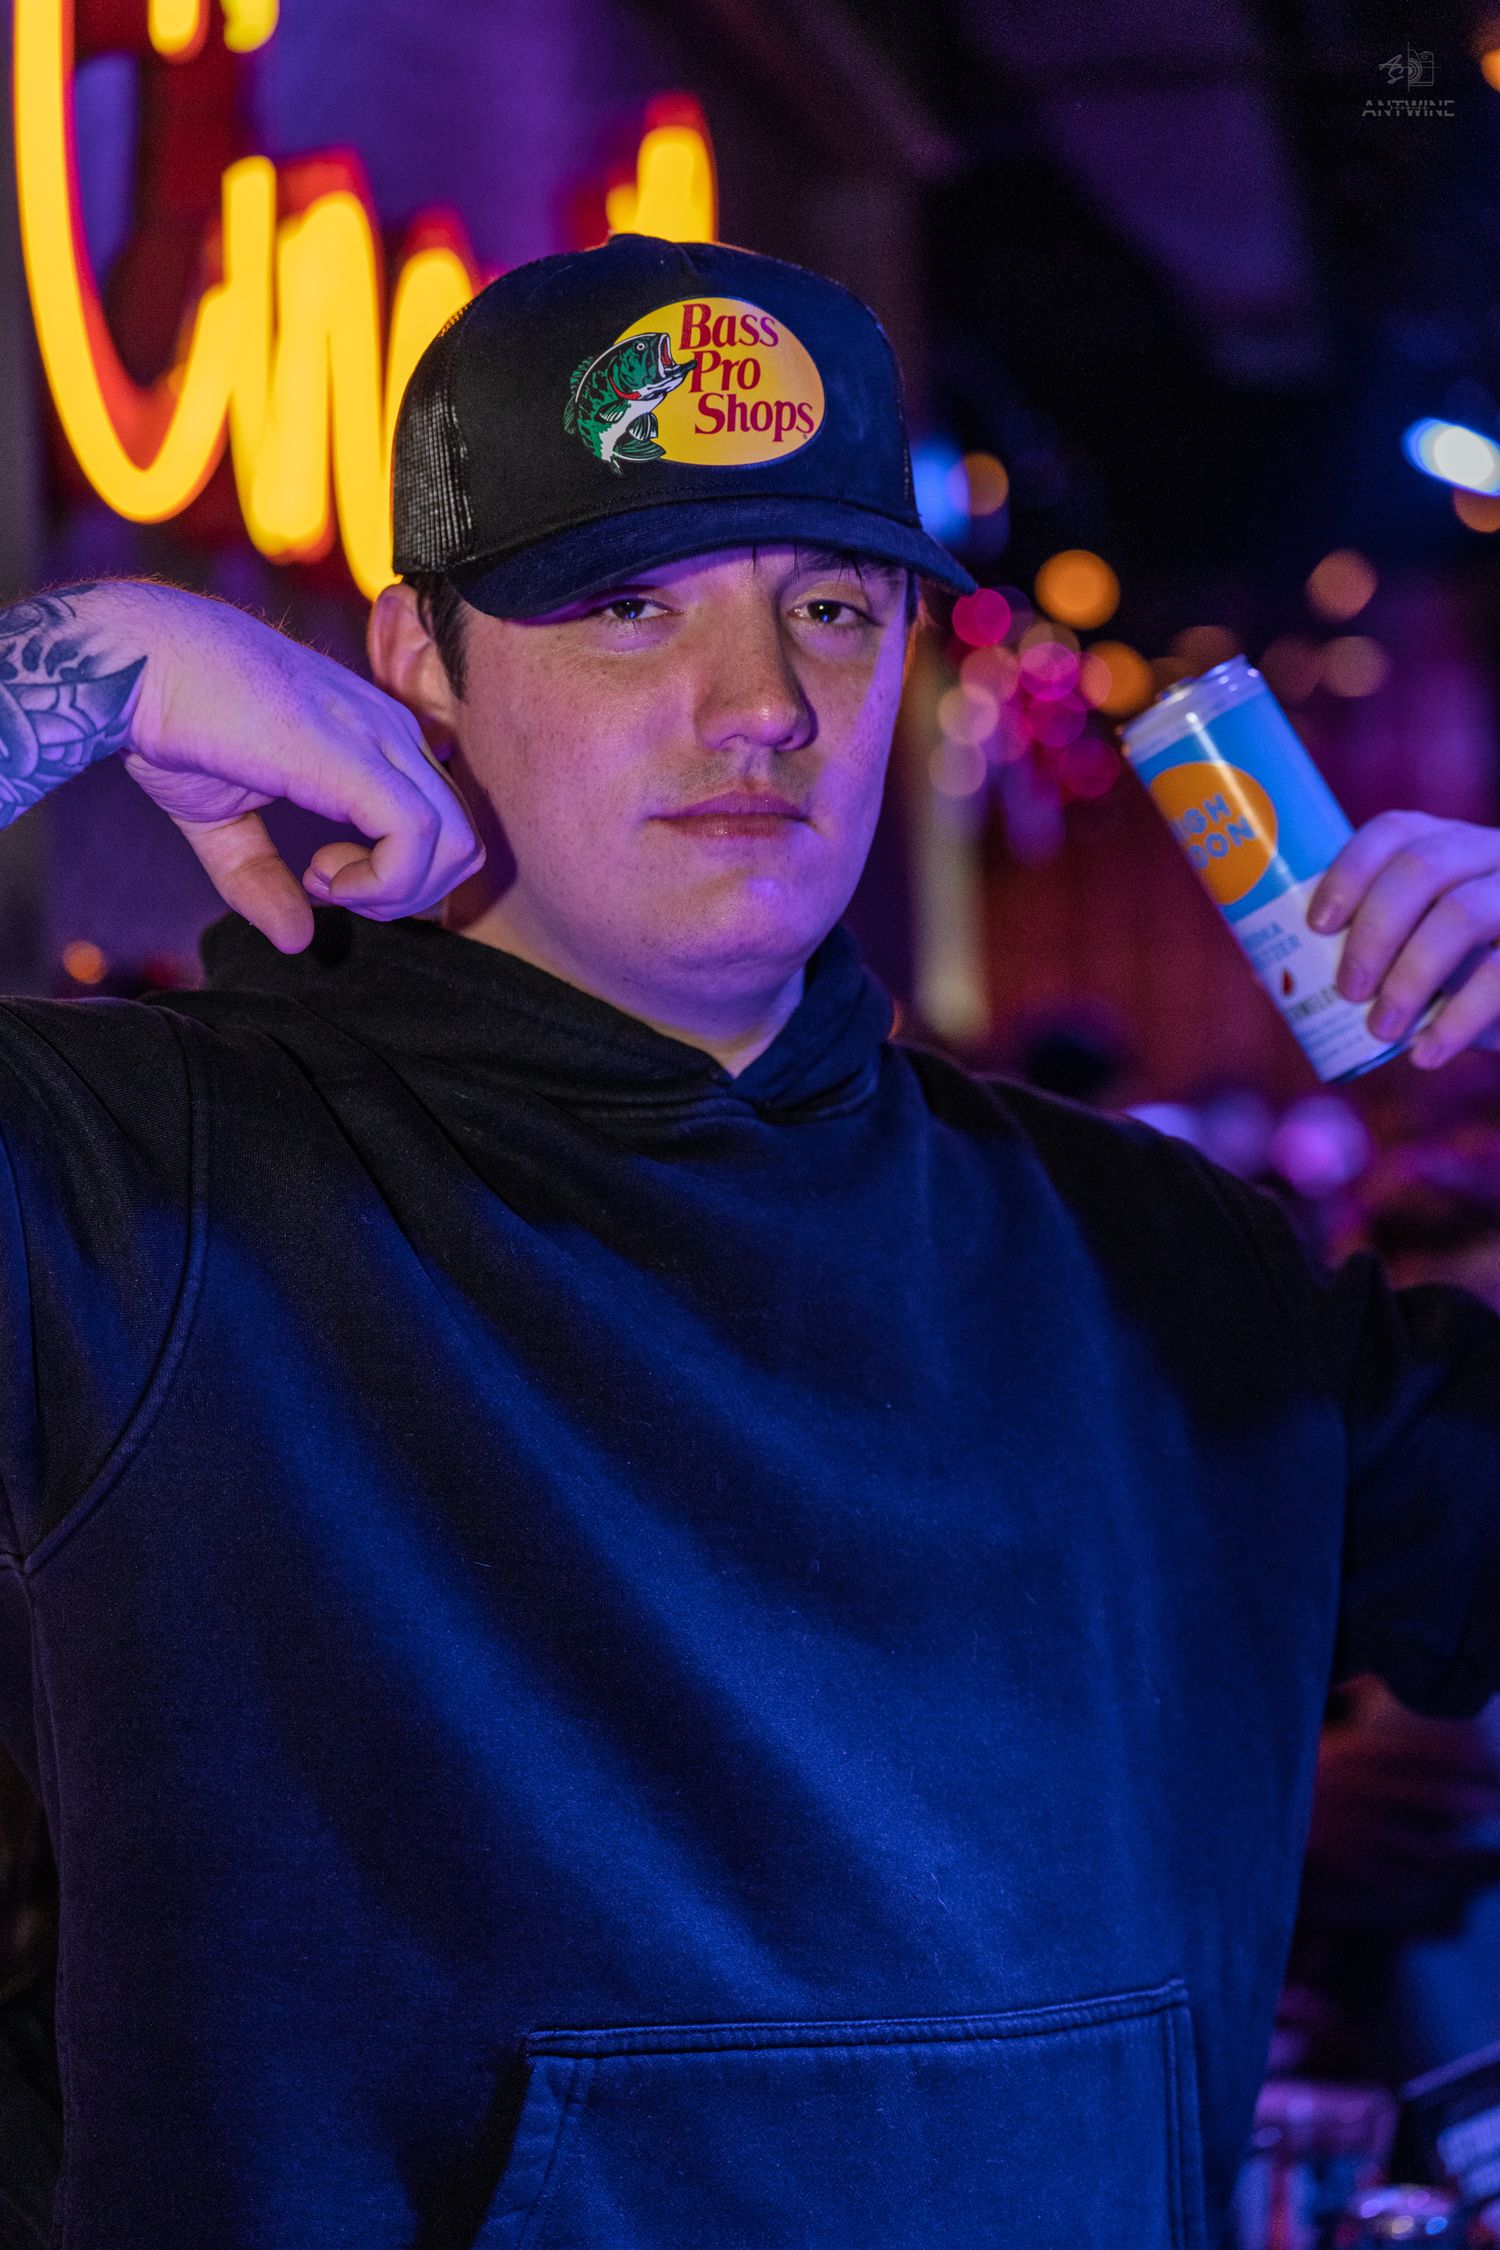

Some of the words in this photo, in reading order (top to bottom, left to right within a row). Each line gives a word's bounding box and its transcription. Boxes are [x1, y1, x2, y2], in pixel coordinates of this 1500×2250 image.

[679, 303, 779, 350] Bass
[688, 350, 761, 393] Pro
[694, 392, 815, 443] Shops
[1185, 815, 1257, 870] OON
